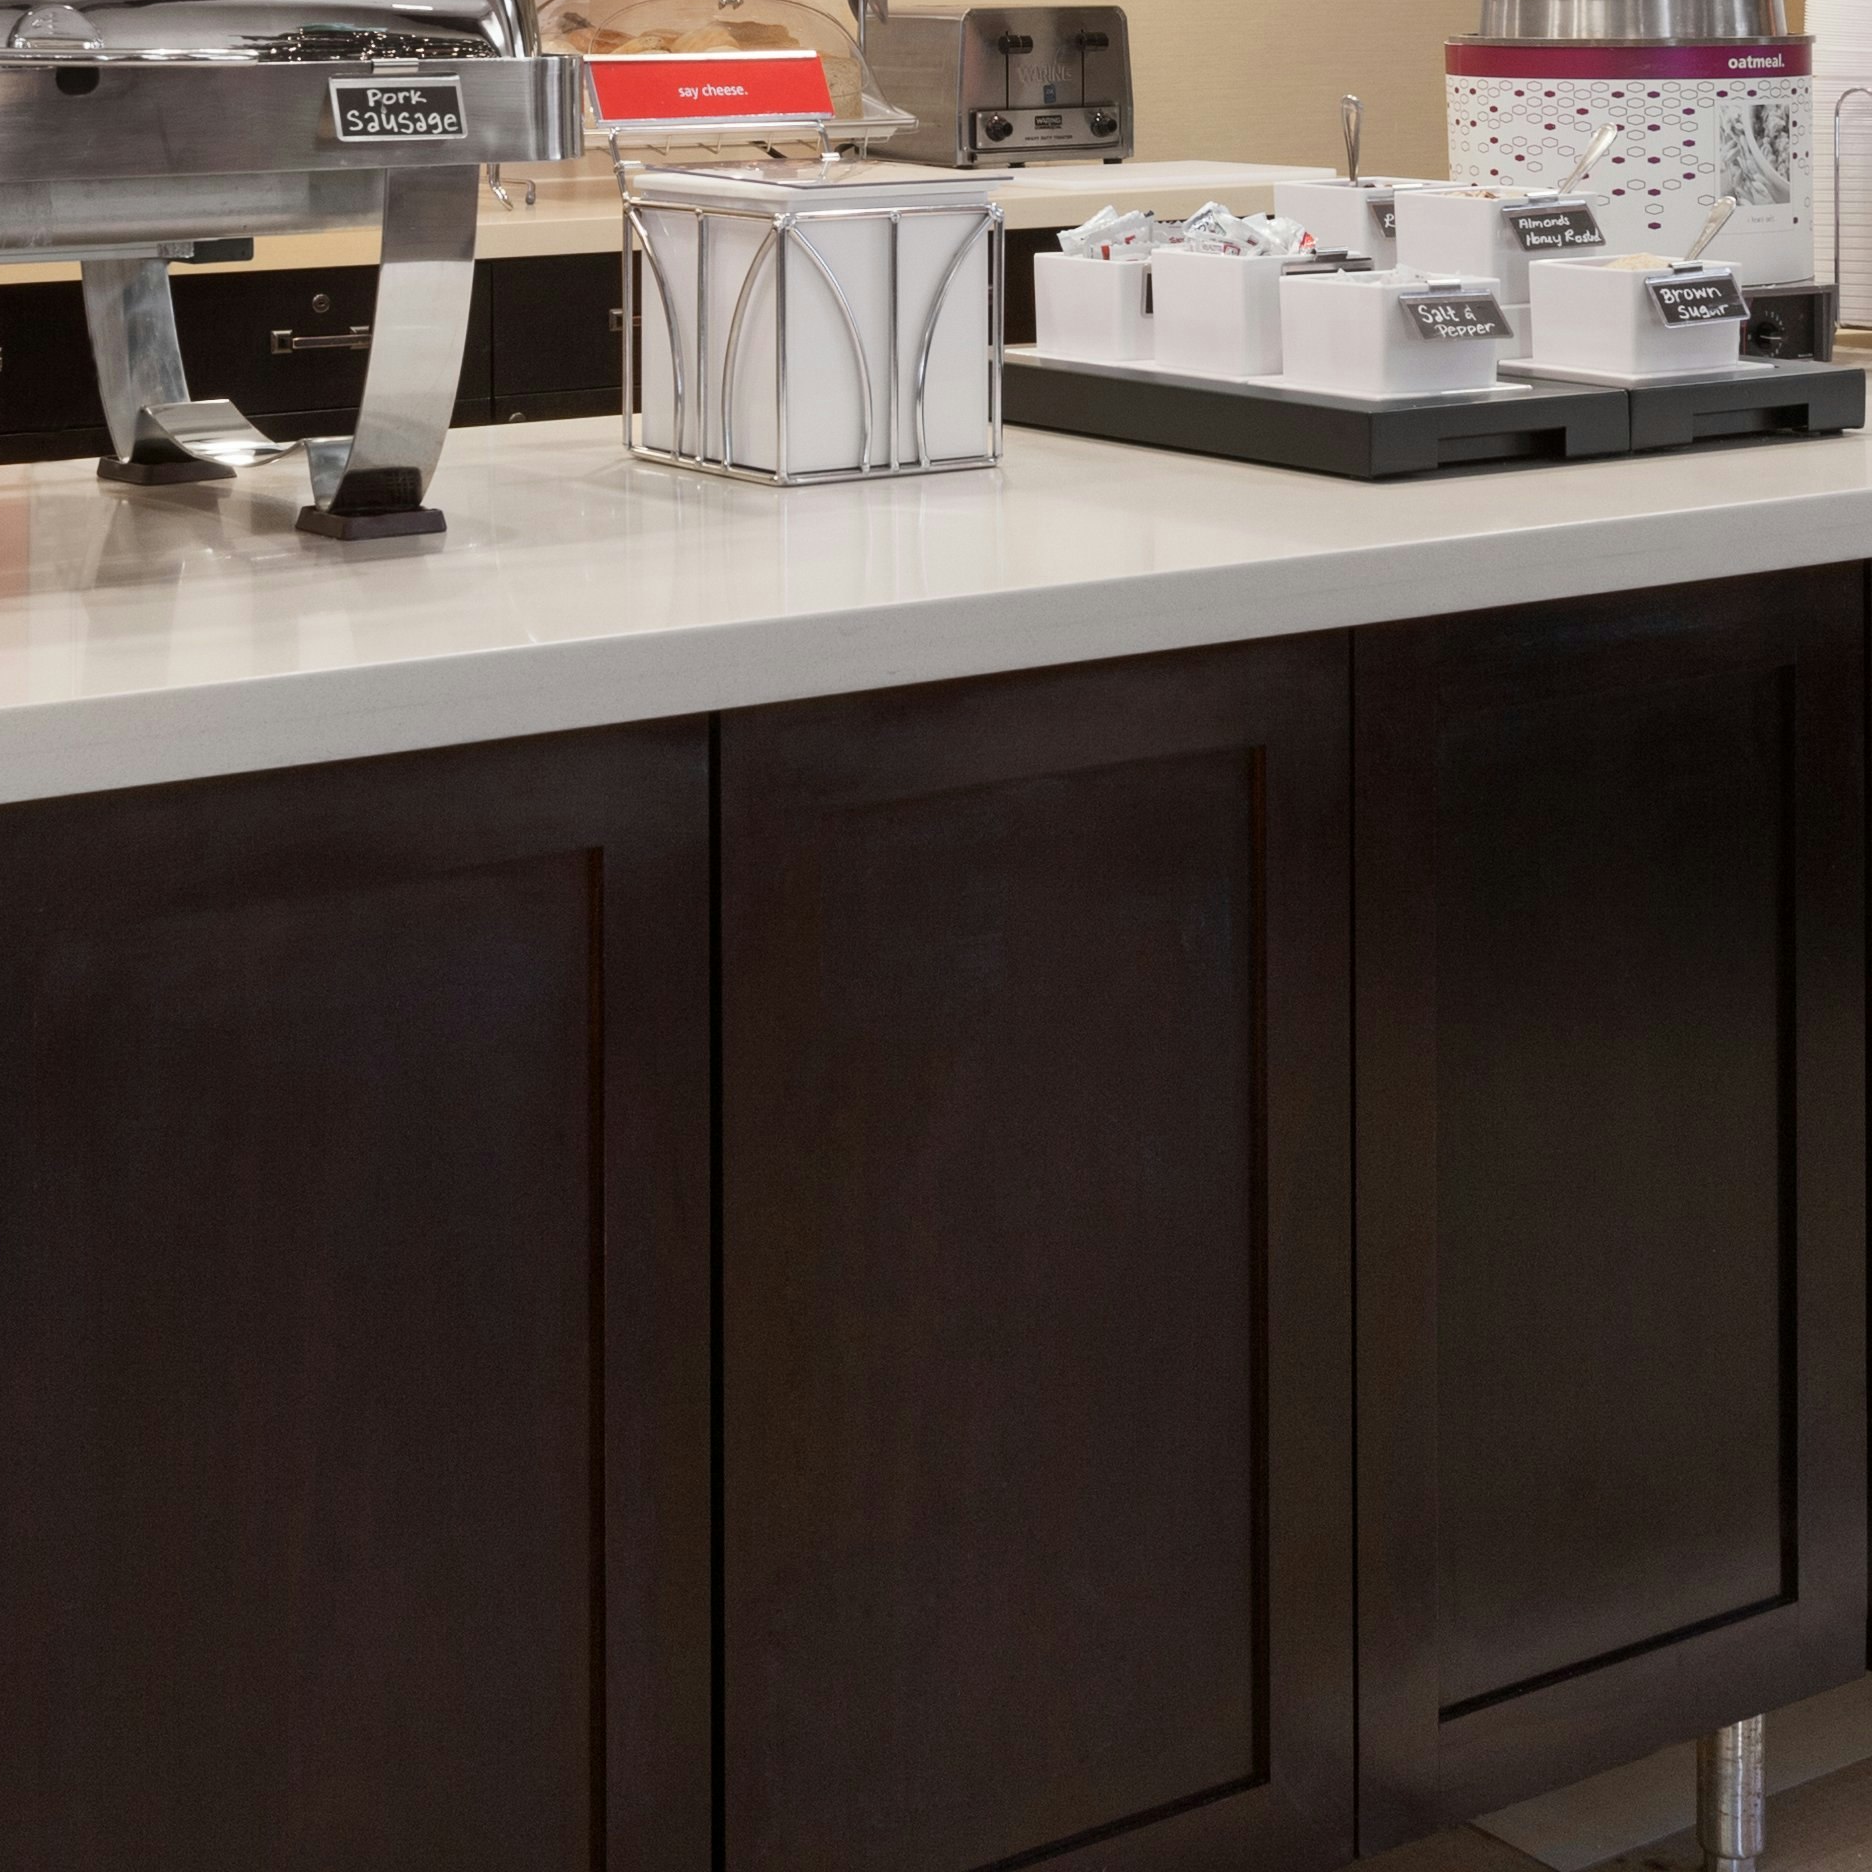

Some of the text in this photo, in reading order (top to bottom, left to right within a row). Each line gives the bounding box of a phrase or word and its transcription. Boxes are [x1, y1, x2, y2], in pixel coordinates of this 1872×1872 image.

[1728, 53, 1785, 69] oatmeal.
[366, 89, 427, 107] Pork
[677, 83, 748, 100] say cheese.
[346, 110, 459, 134] Sausage
[1518, 214, 1570, 229] Almonds
[1659, 285, 1722, 305] Brown
[1418, 304, 1460, 324] Salt
[1434, 322, 1495, 338] Pepper
